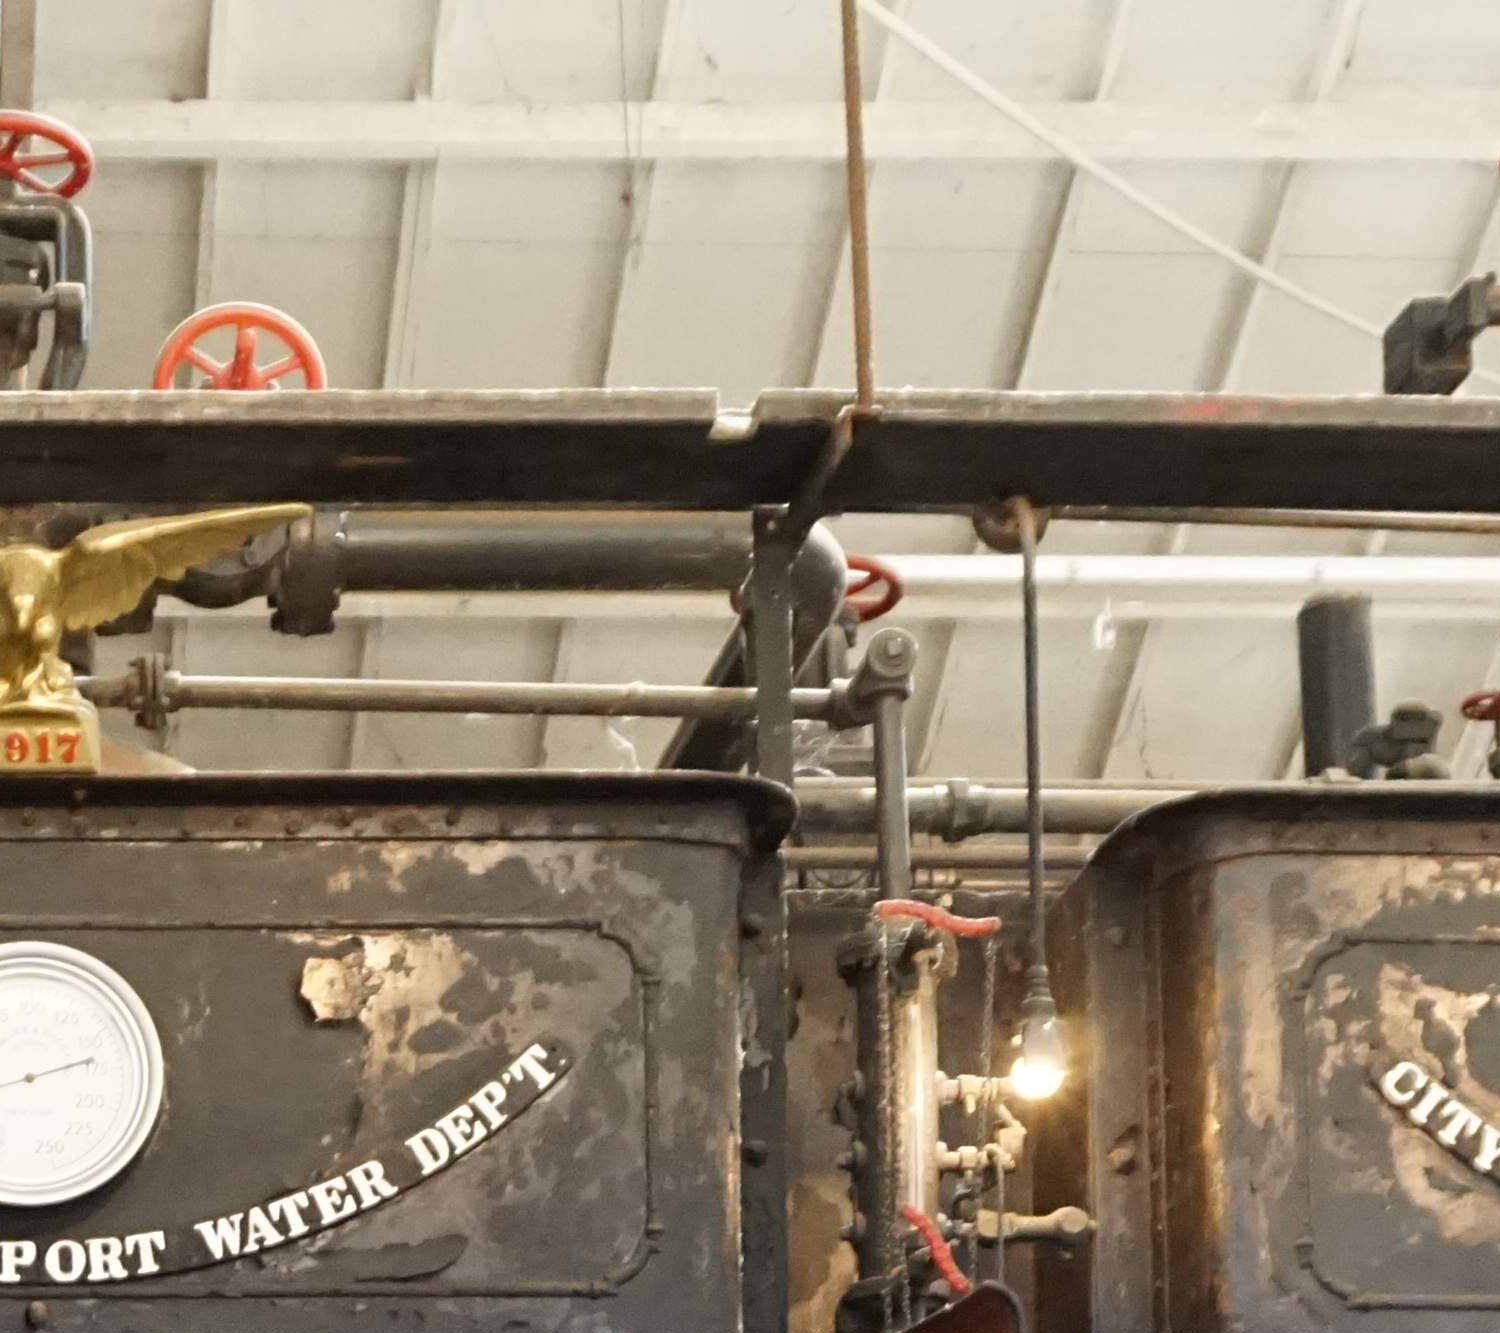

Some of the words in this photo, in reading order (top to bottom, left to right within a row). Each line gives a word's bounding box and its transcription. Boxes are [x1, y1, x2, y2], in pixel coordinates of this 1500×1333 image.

[18, 1000, 46, 1016] 100
[54, 1009, 80, 1025] 125
[78, 1033, 103, 1049] 150
[85, 1060, 109, 1076] 175
[74, 1094, 105, 1110] 200
[63, 1121, 94, 1136] 225
[34, 1139, 65, 1154] 250
[193, 1159, 399, 1260] WATER
[404, 1043, 556, 1177] DEP'T
